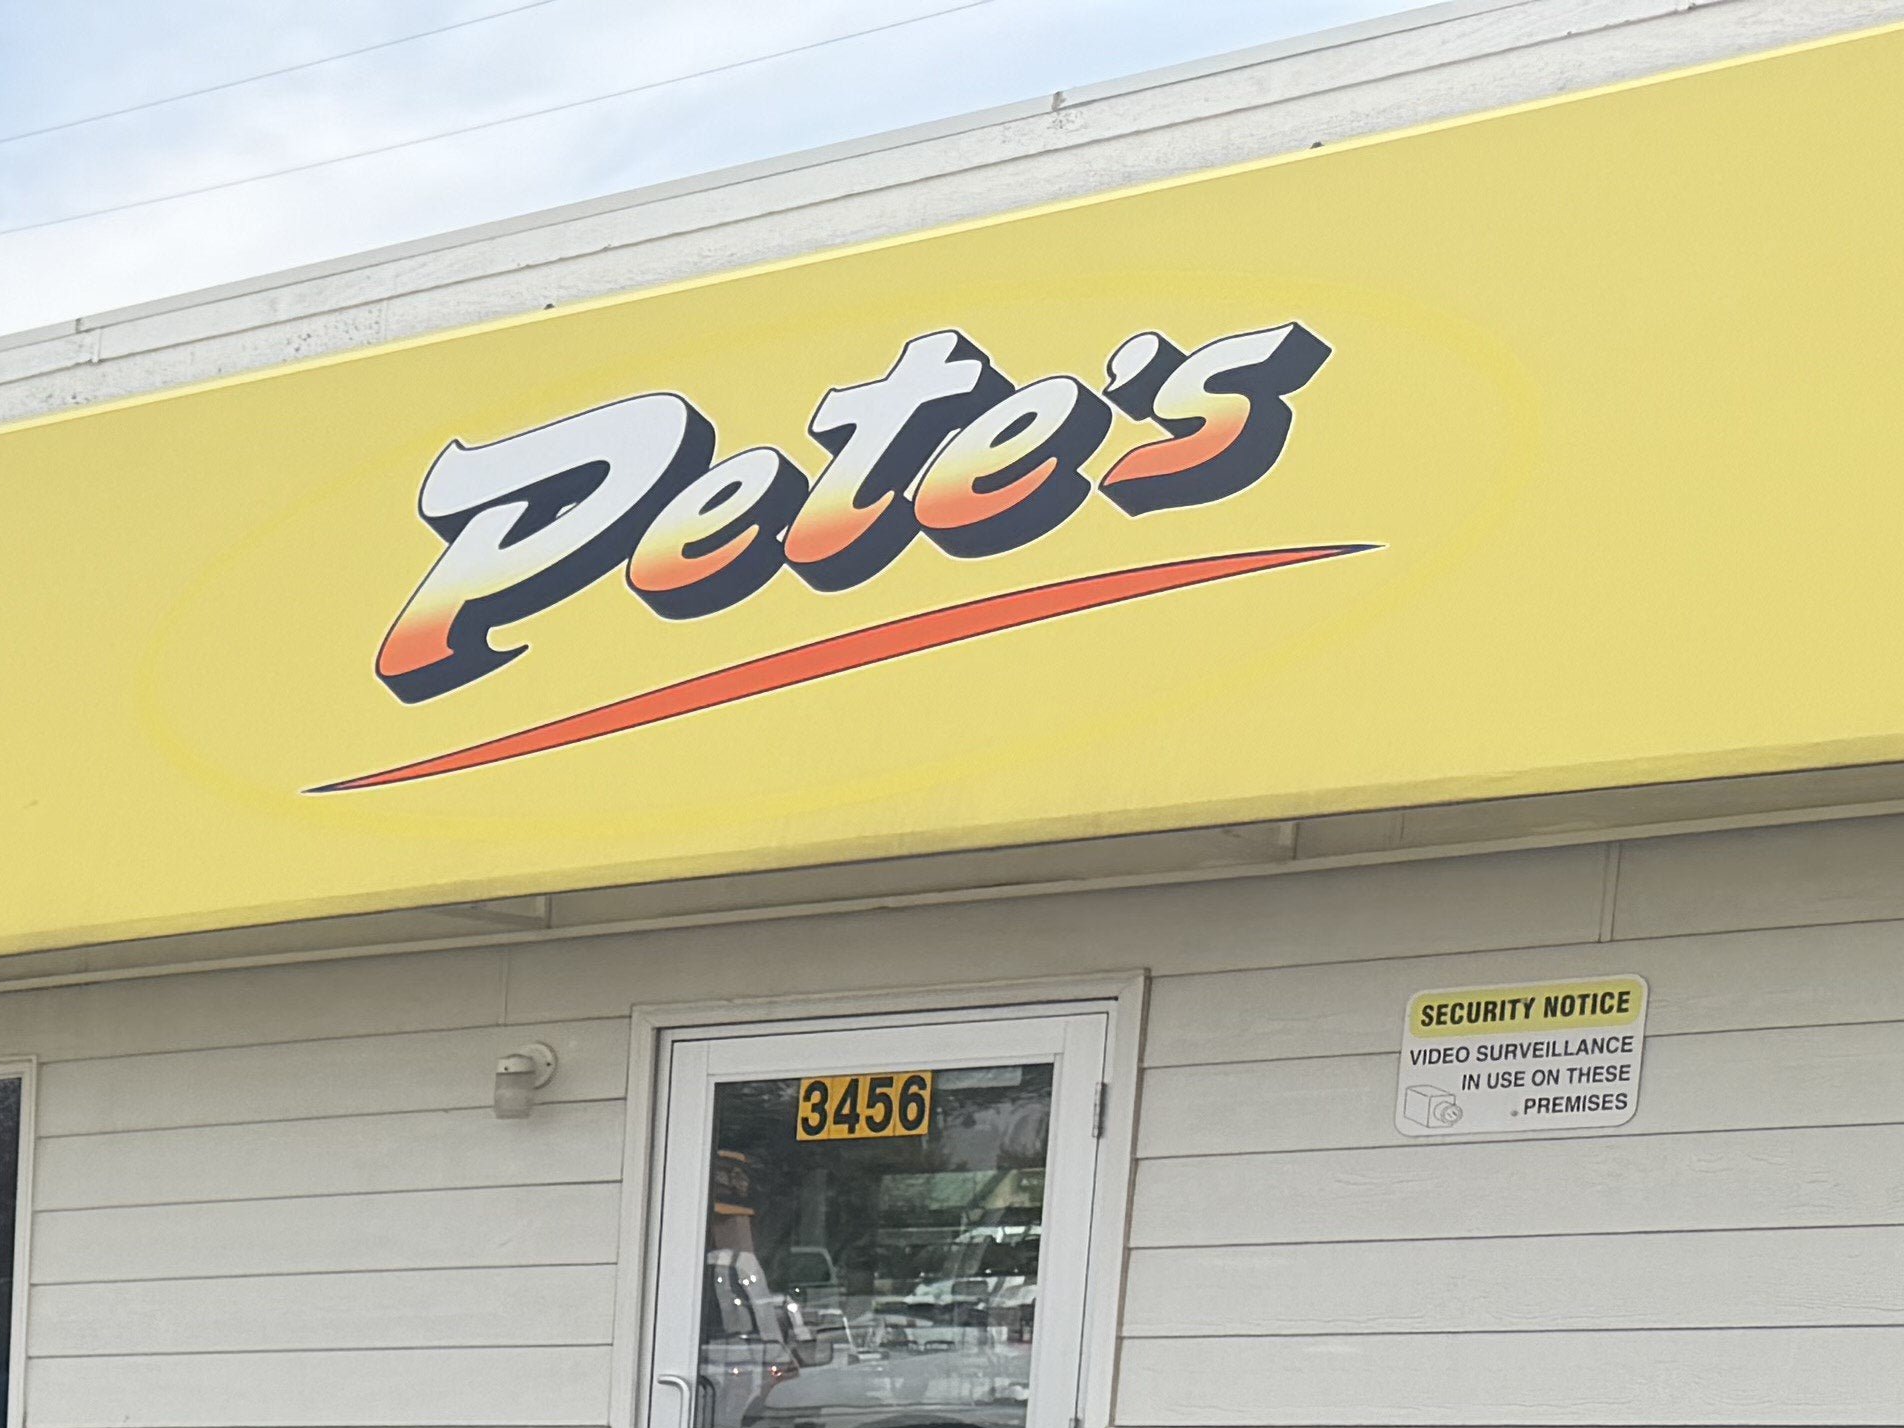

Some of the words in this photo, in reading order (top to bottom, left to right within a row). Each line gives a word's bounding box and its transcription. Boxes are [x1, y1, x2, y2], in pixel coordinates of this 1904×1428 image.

[374, 319, 1332, 704] Pete's
[1421, 996, 1535, 1027] SECURITY
[1543, 990, 1631, 1019] NOTICE
[1410, 1046, 1470, 1066] VIDEO
[1476, 1035, 1634, 1063] SURVEILLANCE
[1462, 1073, 1481, 1091] IN
[1487, 1071, 1526, 1089] USE
[1532, 1068, 1560, 1087] ON
[1567, 1064, 1632, 1084] THESE
[800, 1073, 929, 1137] 3456
[1524, 1092, 1628, 1116] PREMISES
